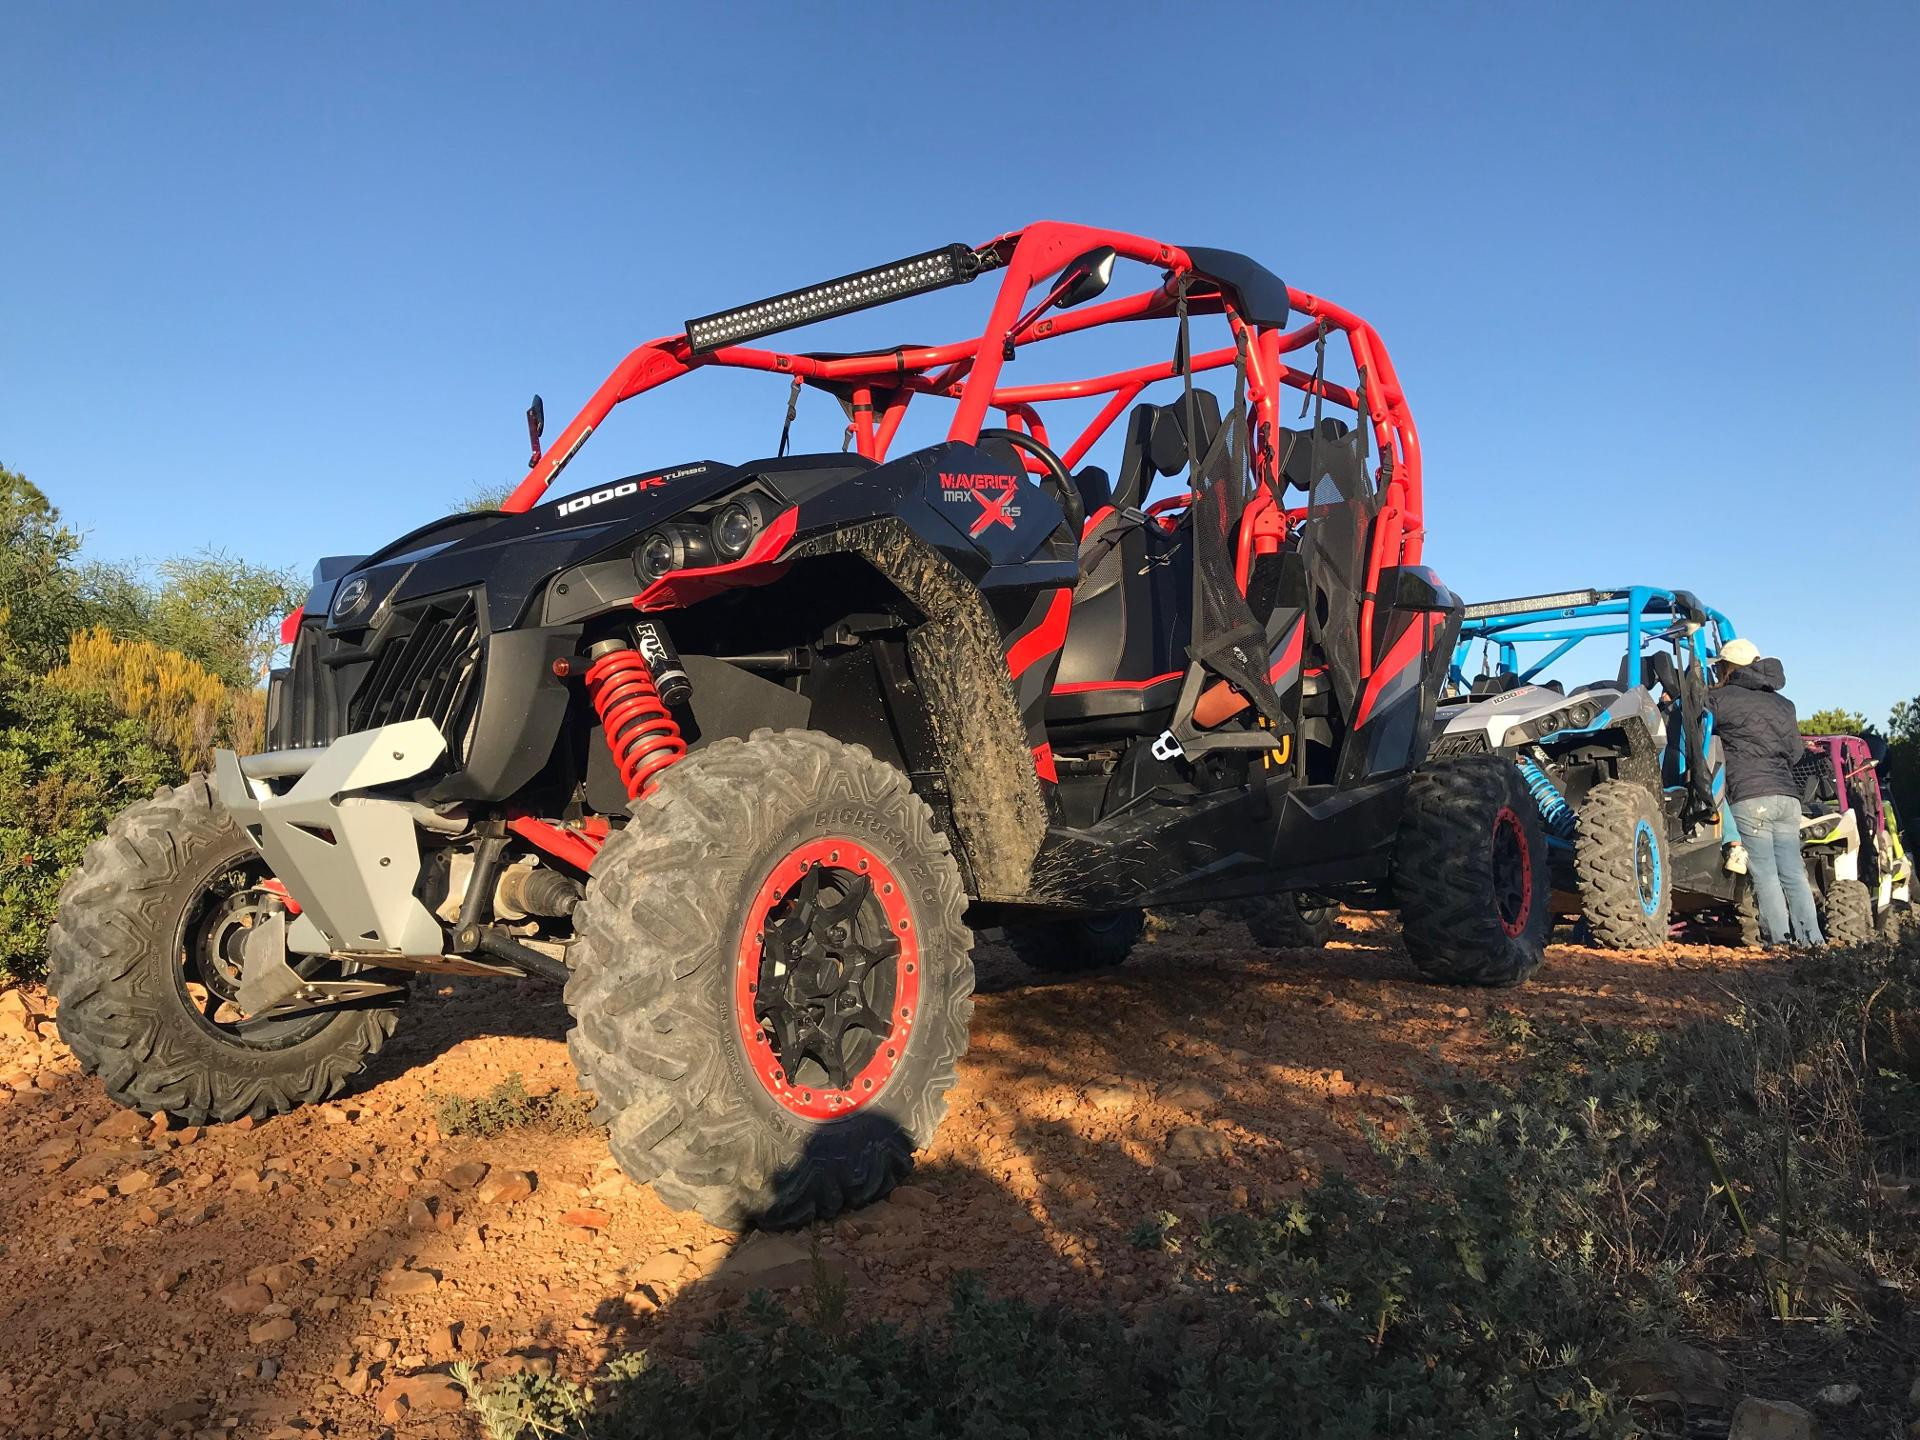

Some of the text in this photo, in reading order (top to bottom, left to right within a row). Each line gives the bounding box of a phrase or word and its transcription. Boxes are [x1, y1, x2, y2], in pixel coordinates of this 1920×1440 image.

[939, 473, 1019, 490] MAVERICK
[943, 490, 972, 502] MAX
[1001, 507, 1021, 517] RS
[636, 623, 669, 668] FOX
[815, 808, 912, 864] BIGHORN
